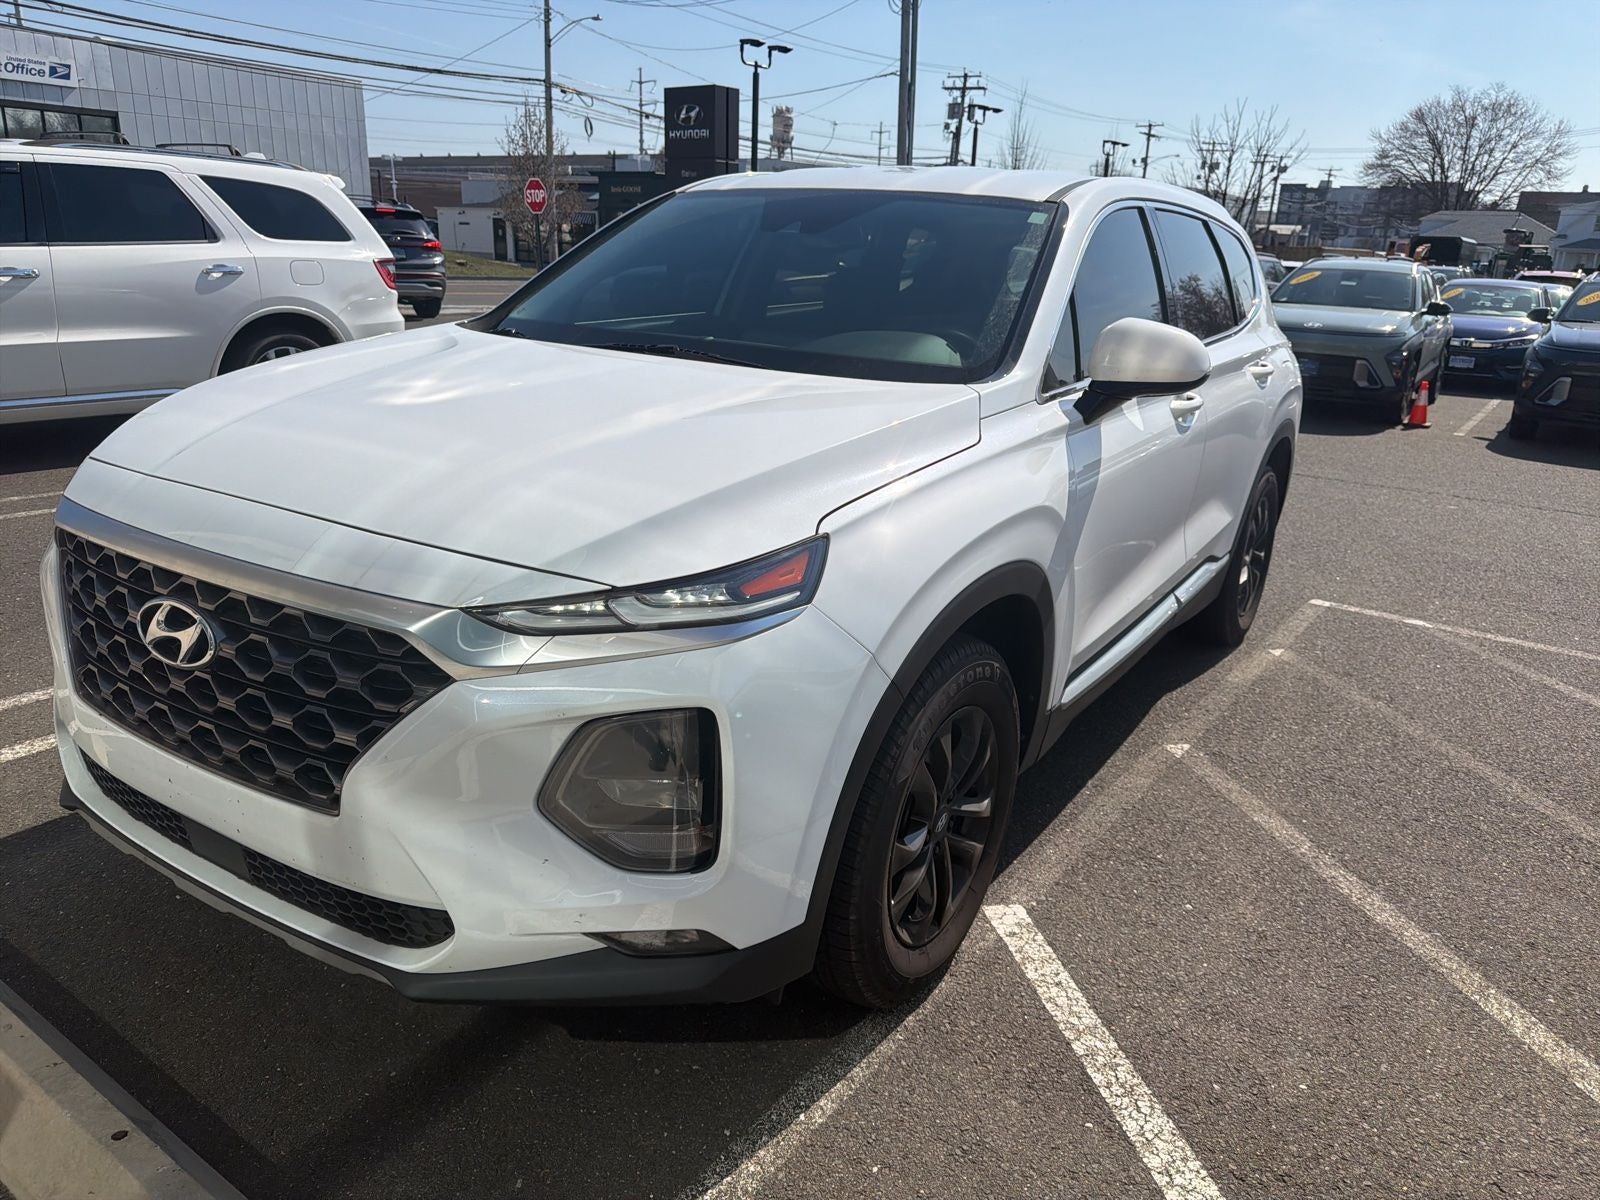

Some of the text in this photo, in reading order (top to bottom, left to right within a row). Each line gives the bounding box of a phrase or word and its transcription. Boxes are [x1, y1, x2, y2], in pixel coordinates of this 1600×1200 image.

[6, 55, 46, 66] United States
[4, 62, 46, 78] Office
[669, 129, 710, 139] HYUNDAI
[526, 190, 545, 203] STOP
